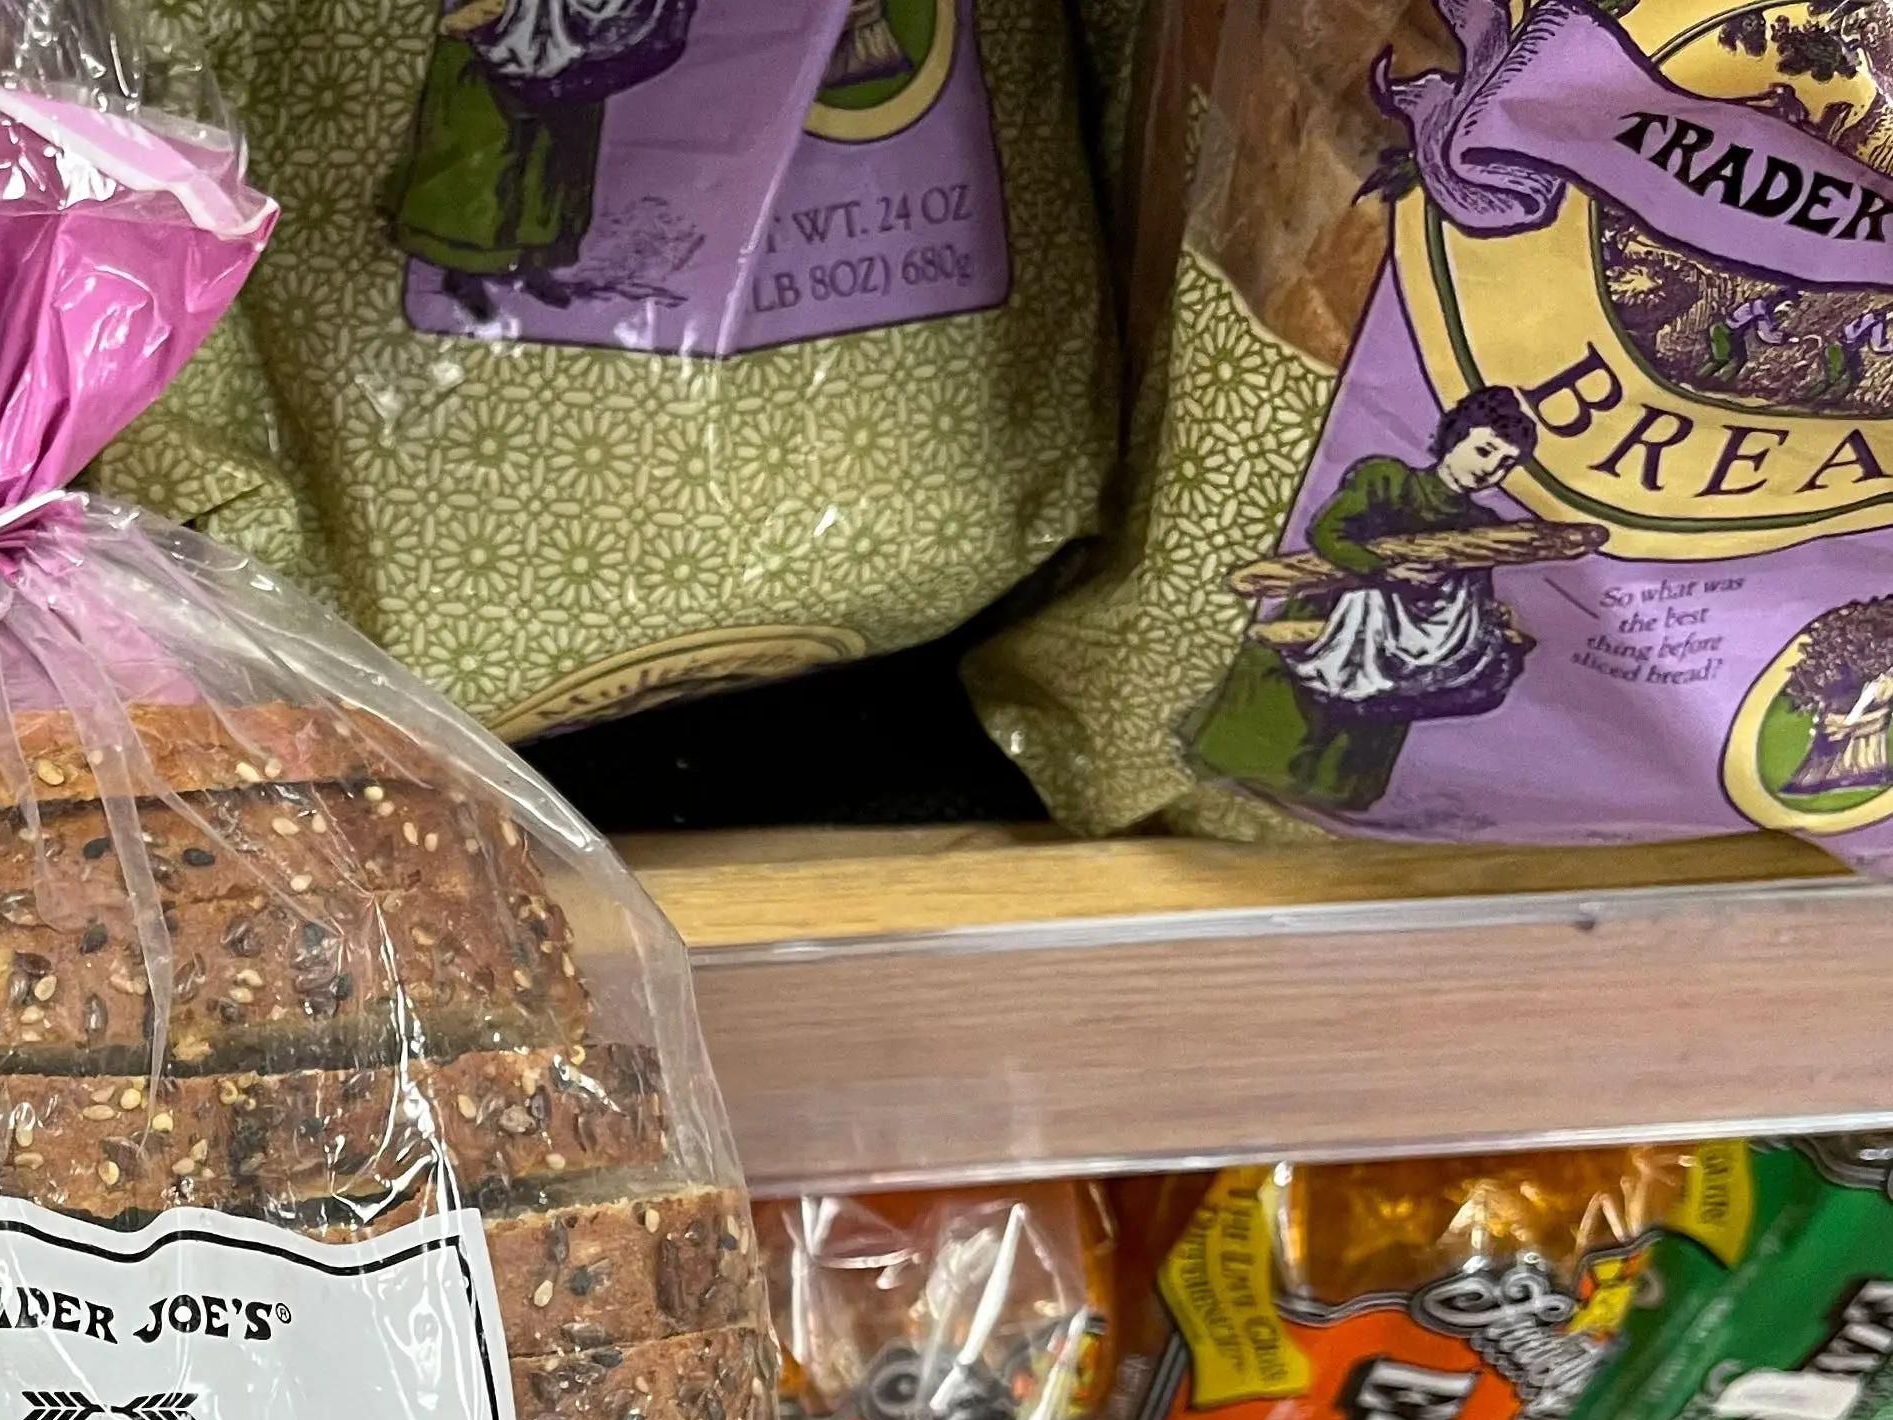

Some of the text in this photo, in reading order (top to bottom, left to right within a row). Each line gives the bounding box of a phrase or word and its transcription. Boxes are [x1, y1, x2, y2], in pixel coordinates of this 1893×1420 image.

[1614, 111, 1893, 243] TRADER
[792, 200, 871, 245] WT.
[879, 190, 913, 233] 24
[920, 183, 975, 225] OZ
[902, 243, 973, 287] 680g
[1600, 576, 1747, 607] So what was
[1618, 605, 1710, 634] the best
[1586, 631, 1723, 663] thing before
[1569, 651, 1724, 685] sliced bread?
